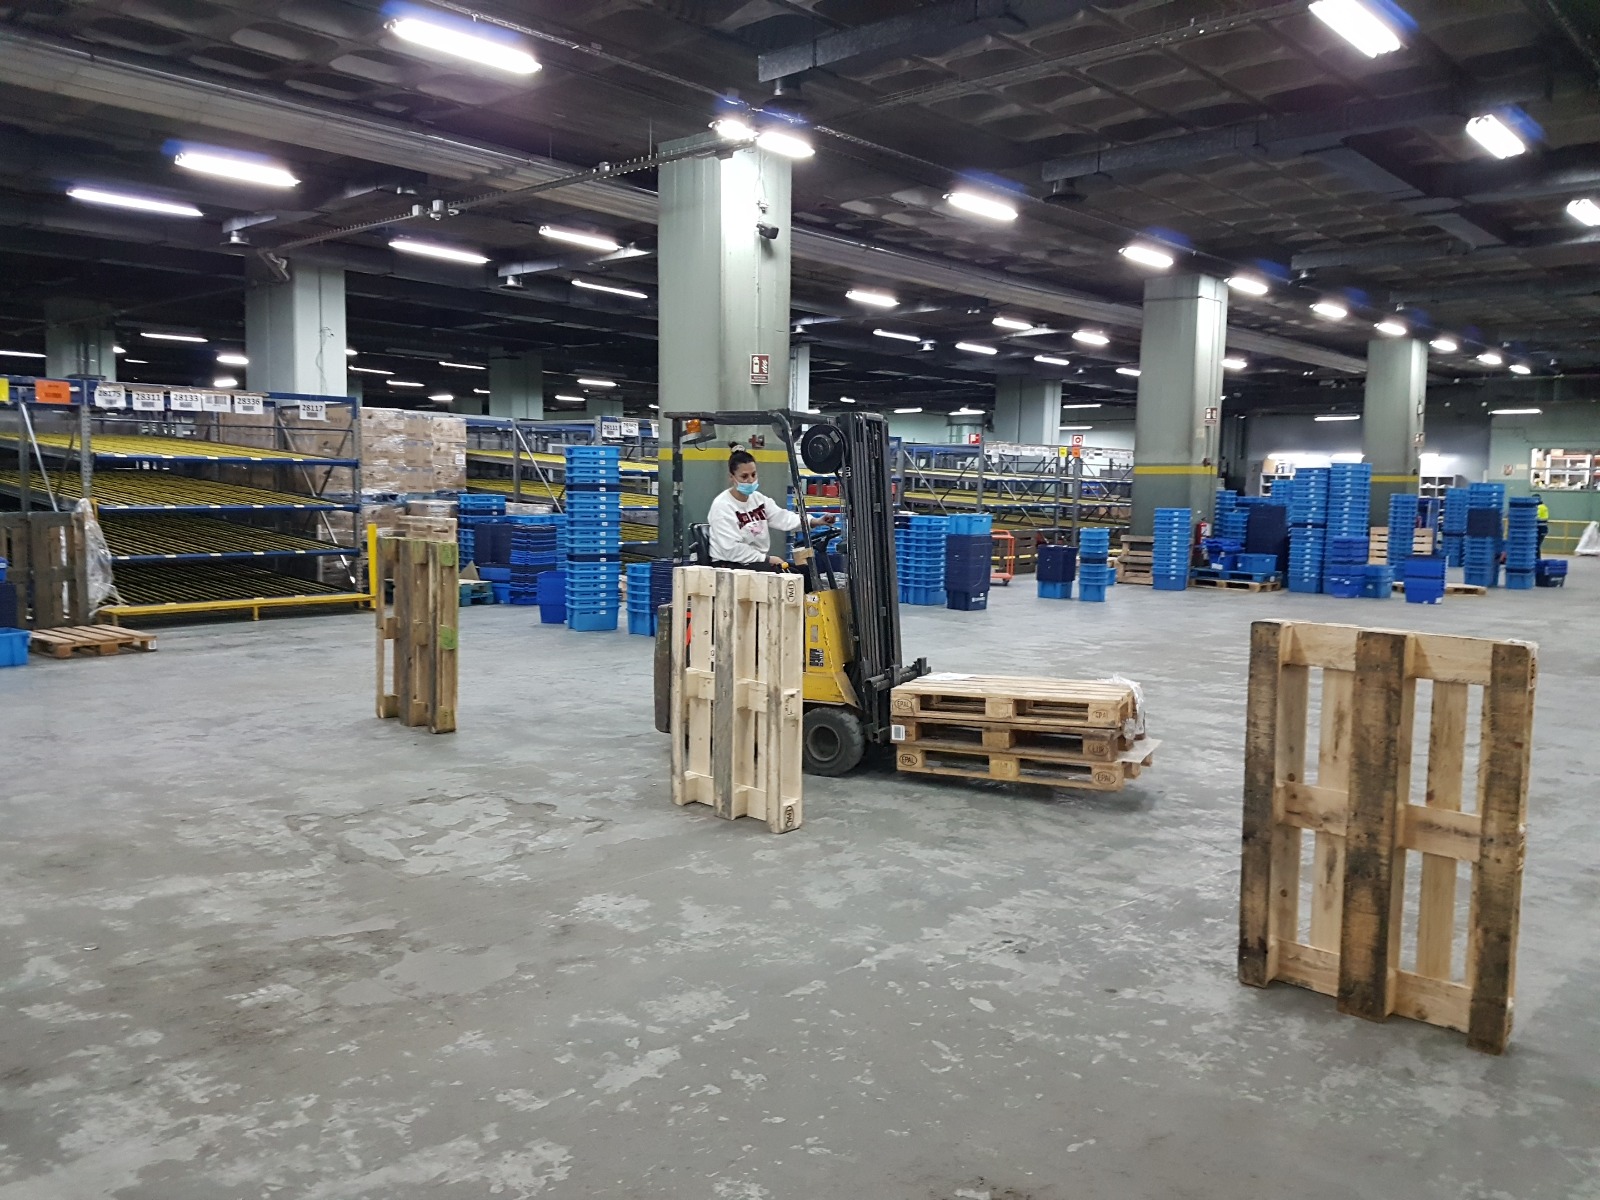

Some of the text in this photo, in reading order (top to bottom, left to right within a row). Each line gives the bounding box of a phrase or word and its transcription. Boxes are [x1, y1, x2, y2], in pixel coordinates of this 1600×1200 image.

[135, 392, 161, 401] 28311
[173, 394, 199, 402] 28133
[237, 397, 261, 405] 28336
[302, 404, 323, 412] 28117
